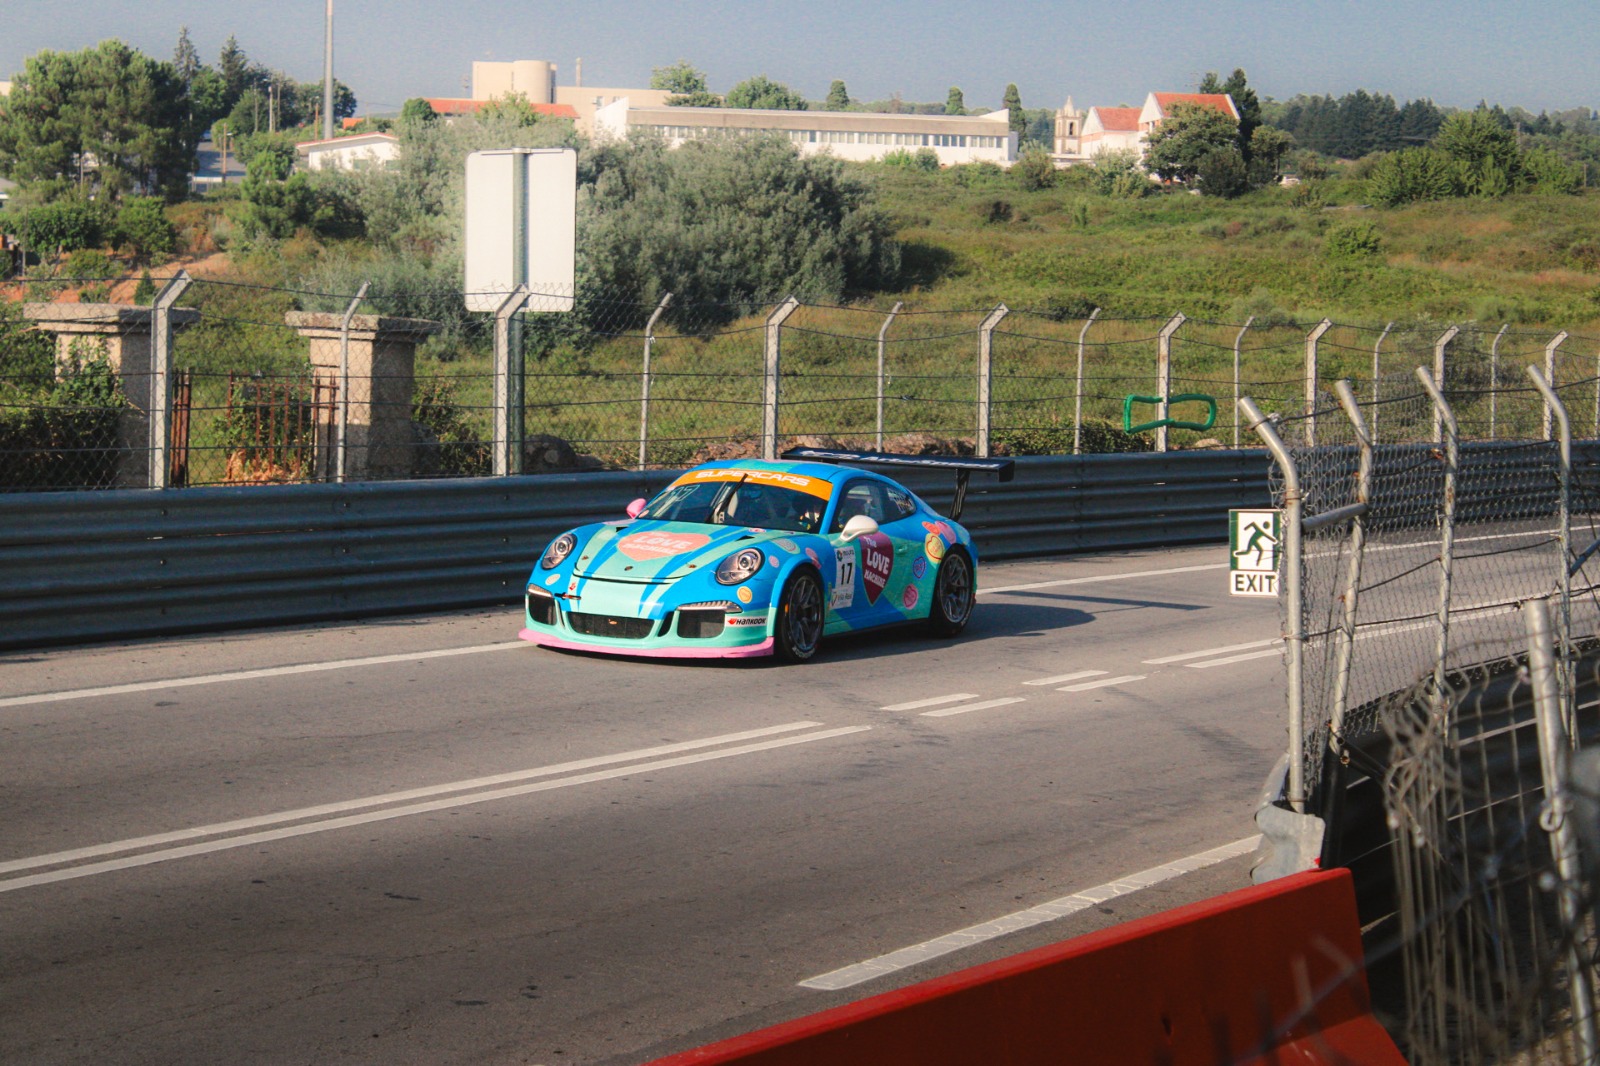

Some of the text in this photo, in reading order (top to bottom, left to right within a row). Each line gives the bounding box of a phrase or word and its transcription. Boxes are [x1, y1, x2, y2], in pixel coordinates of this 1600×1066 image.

[695, 470, 811, 487] SUPERCARS
[633, 535, 694, 549] LOVE
[866, 548, 890, 575] LOVE
[841, 562, 853, 585] 17
[864, 569, 886, 589] MACHINE
[1235, 574, 1276, 593] EXIT
